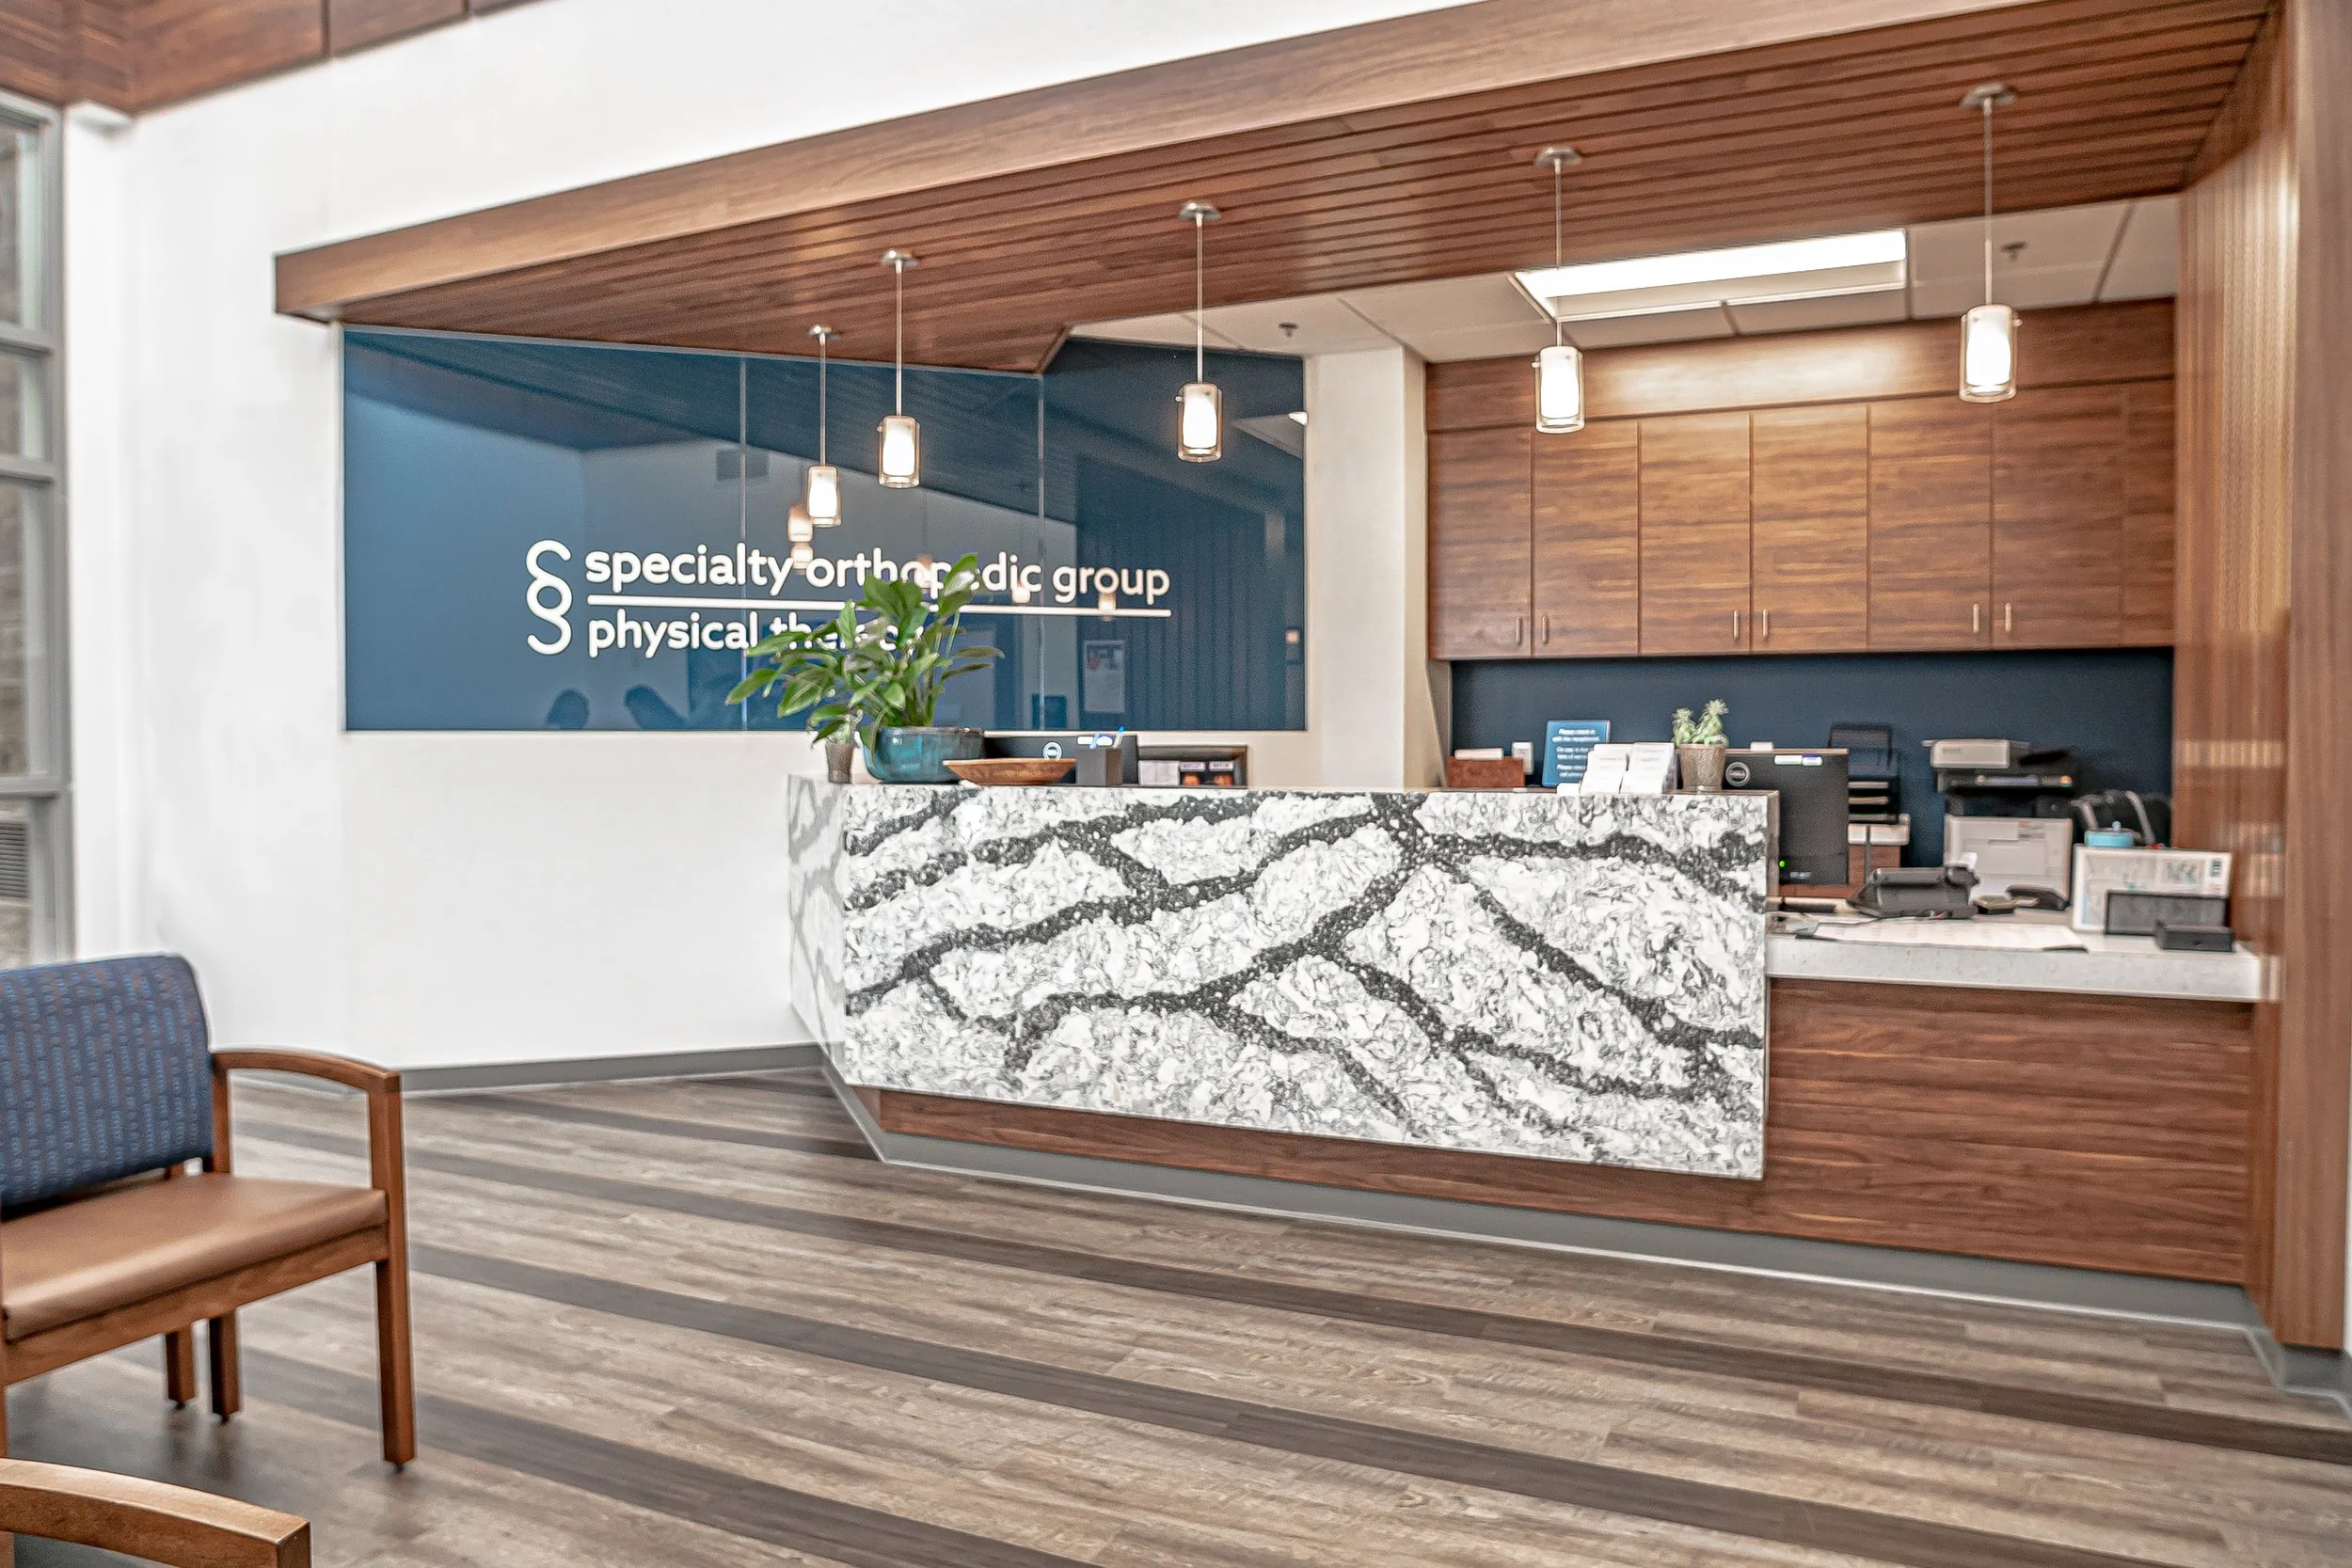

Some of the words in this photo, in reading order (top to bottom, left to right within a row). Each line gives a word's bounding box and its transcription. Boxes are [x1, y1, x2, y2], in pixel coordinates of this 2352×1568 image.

[584, 542, 794, 596] specialty
[805, 547, 1042, 599] orthopdic
[1052, 564, 1170, 605] group
[588, 608, 758, 659] physical
